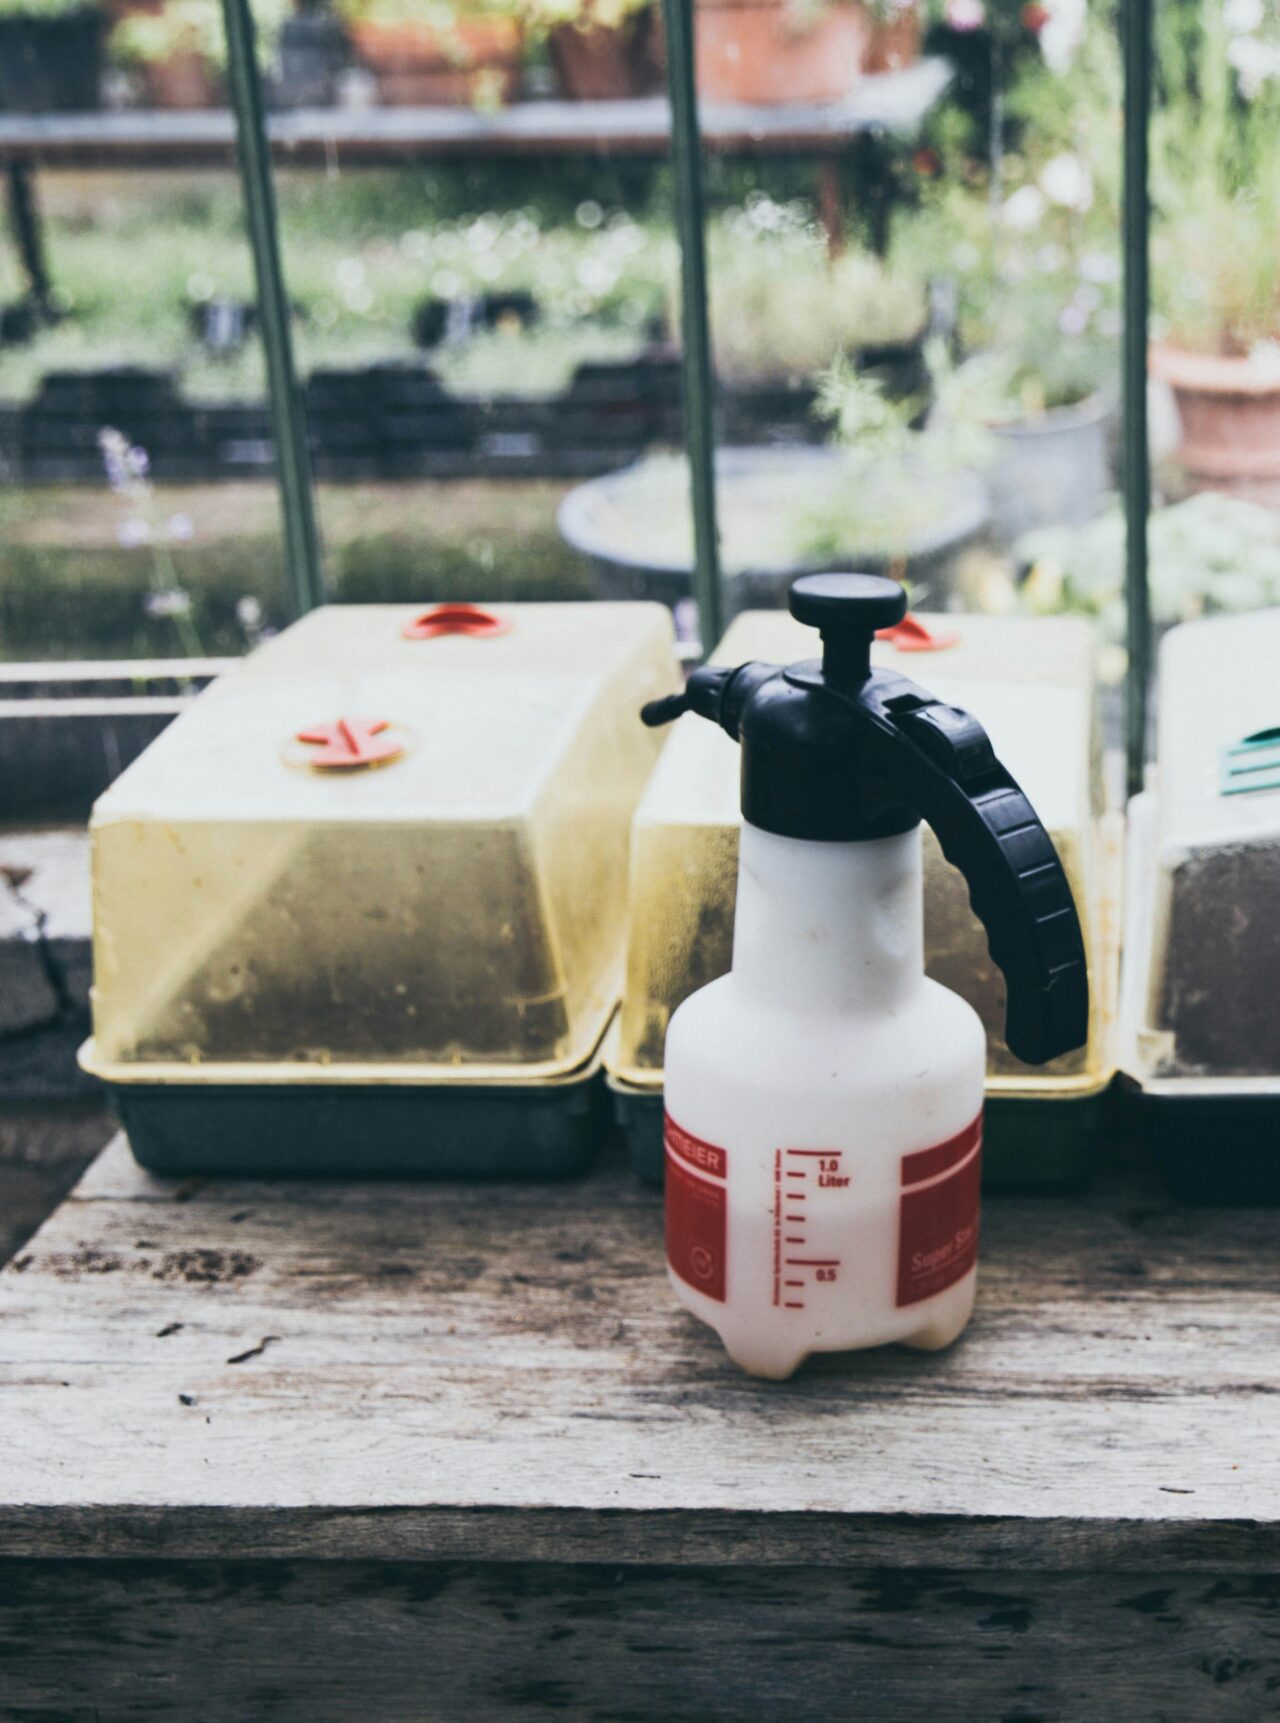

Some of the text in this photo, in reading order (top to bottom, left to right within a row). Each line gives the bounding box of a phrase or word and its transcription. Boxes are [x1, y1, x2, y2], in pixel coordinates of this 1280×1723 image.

[819, 1159, 838, 1172] 1.0
[818, 1174, 850, 1188] Liter
[816, 1268, 837, 1282] 0.5
